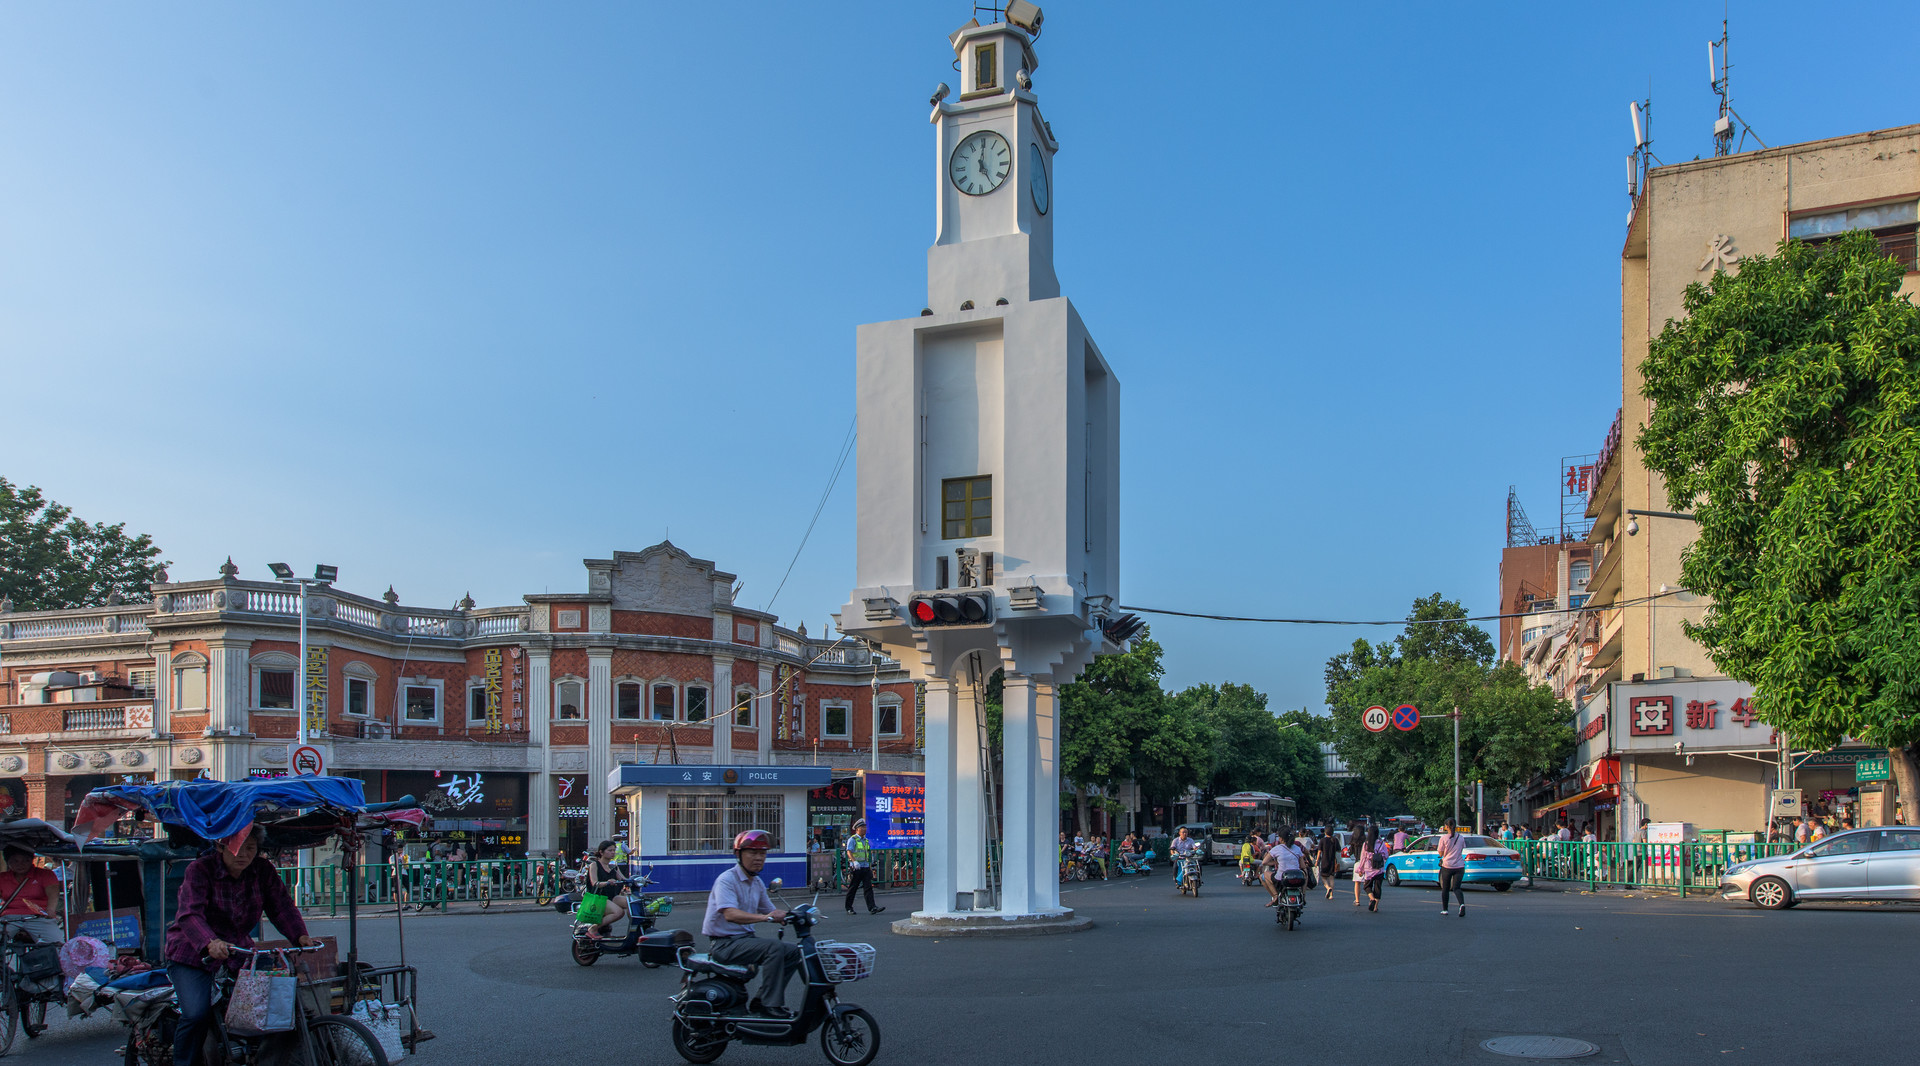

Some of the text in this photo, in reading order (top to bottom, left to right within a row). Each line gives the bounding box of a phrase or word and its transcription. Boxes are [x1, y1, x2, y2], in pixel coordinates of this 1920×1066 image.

[1369, 713, 1384, 725] 40
[682, 771, 712, 781] 公安
[749, 772, 778, 780] POLICE
[875, 797, 925, 813] 到泉兴
